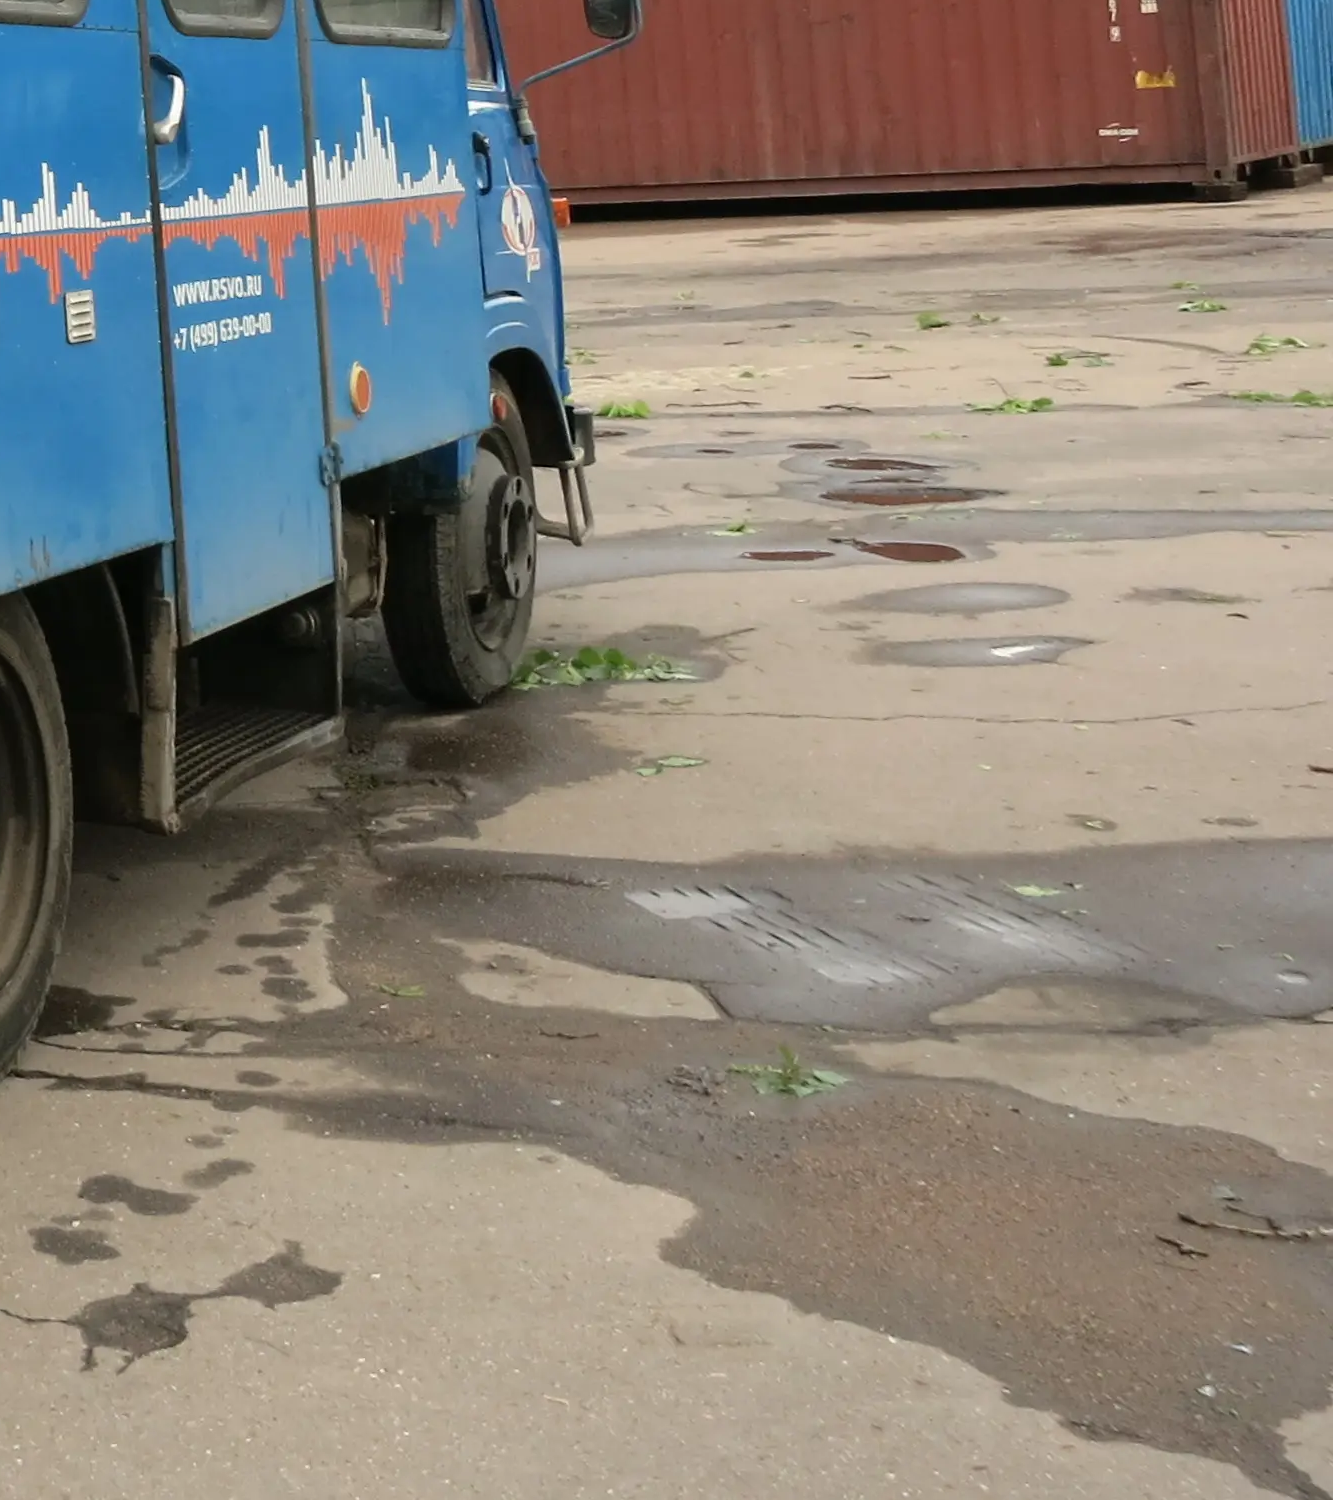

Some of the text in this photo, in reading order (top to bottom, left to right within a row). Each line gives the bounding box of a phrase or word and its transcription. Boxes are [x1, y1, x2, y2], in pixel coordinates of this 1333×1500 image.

[173, 274, 263, 308] WWW.RSVO.RU
[173, 311, 272, 353] +7 (499) 639-00-00
